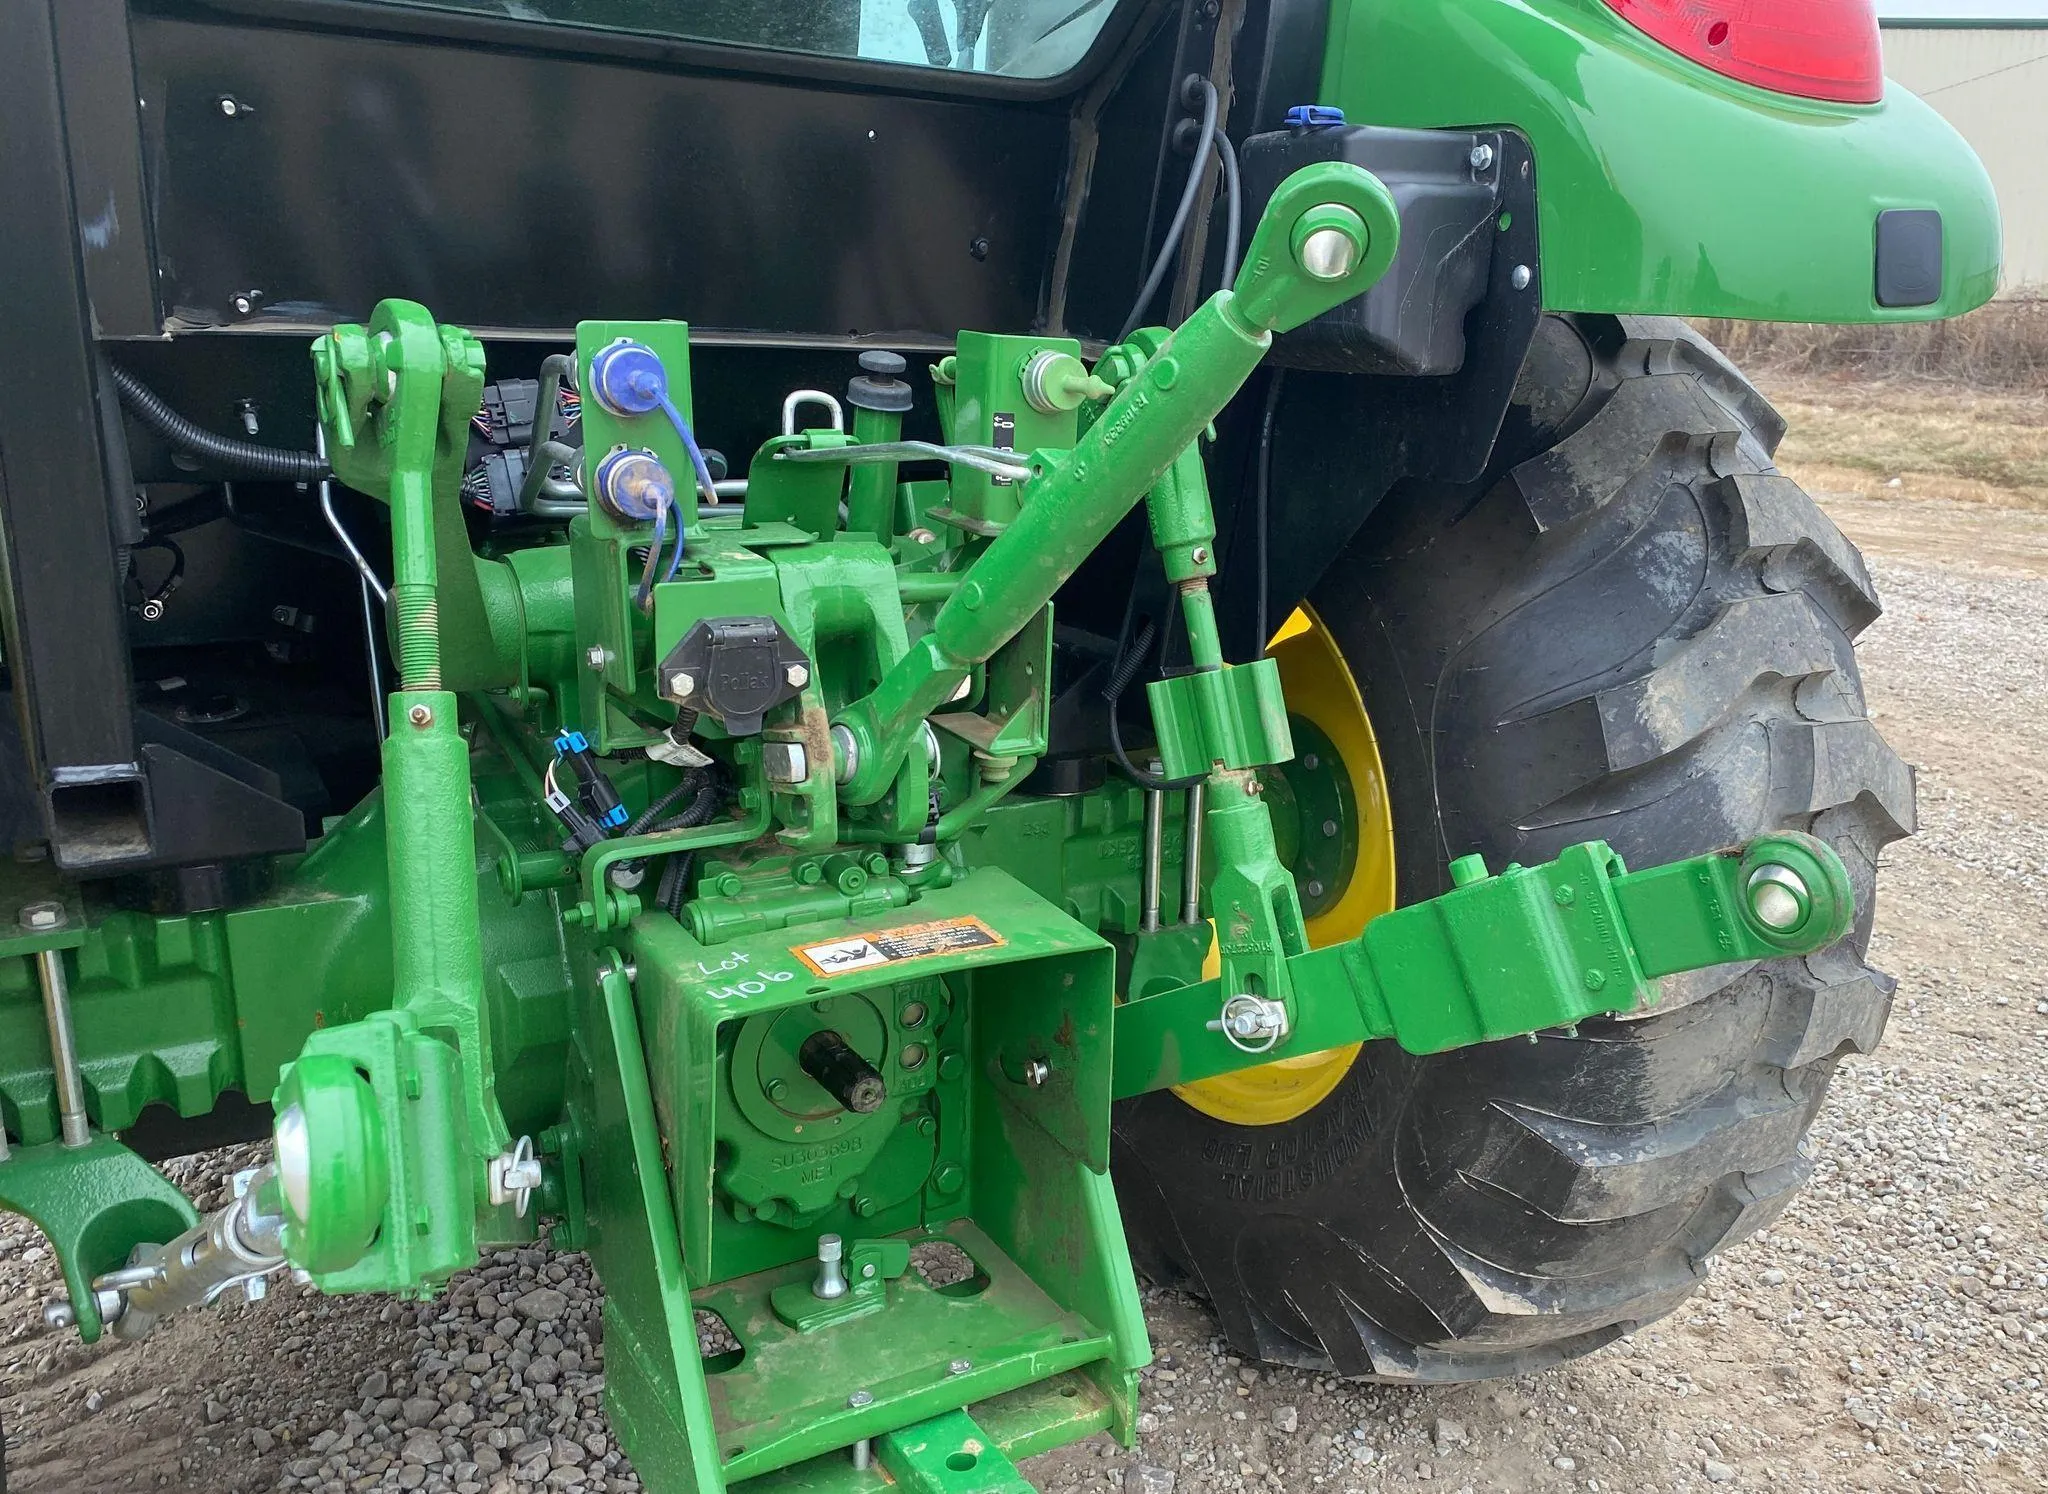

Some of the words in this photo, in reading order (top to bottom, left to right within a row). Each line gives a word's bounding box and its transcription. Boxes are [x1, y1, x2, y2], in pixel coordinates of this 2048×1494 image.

[719, 671, 769, 690] Pollak
[698, 951, 750, 975] Lot
[705, 971, 794, 1000] 406
